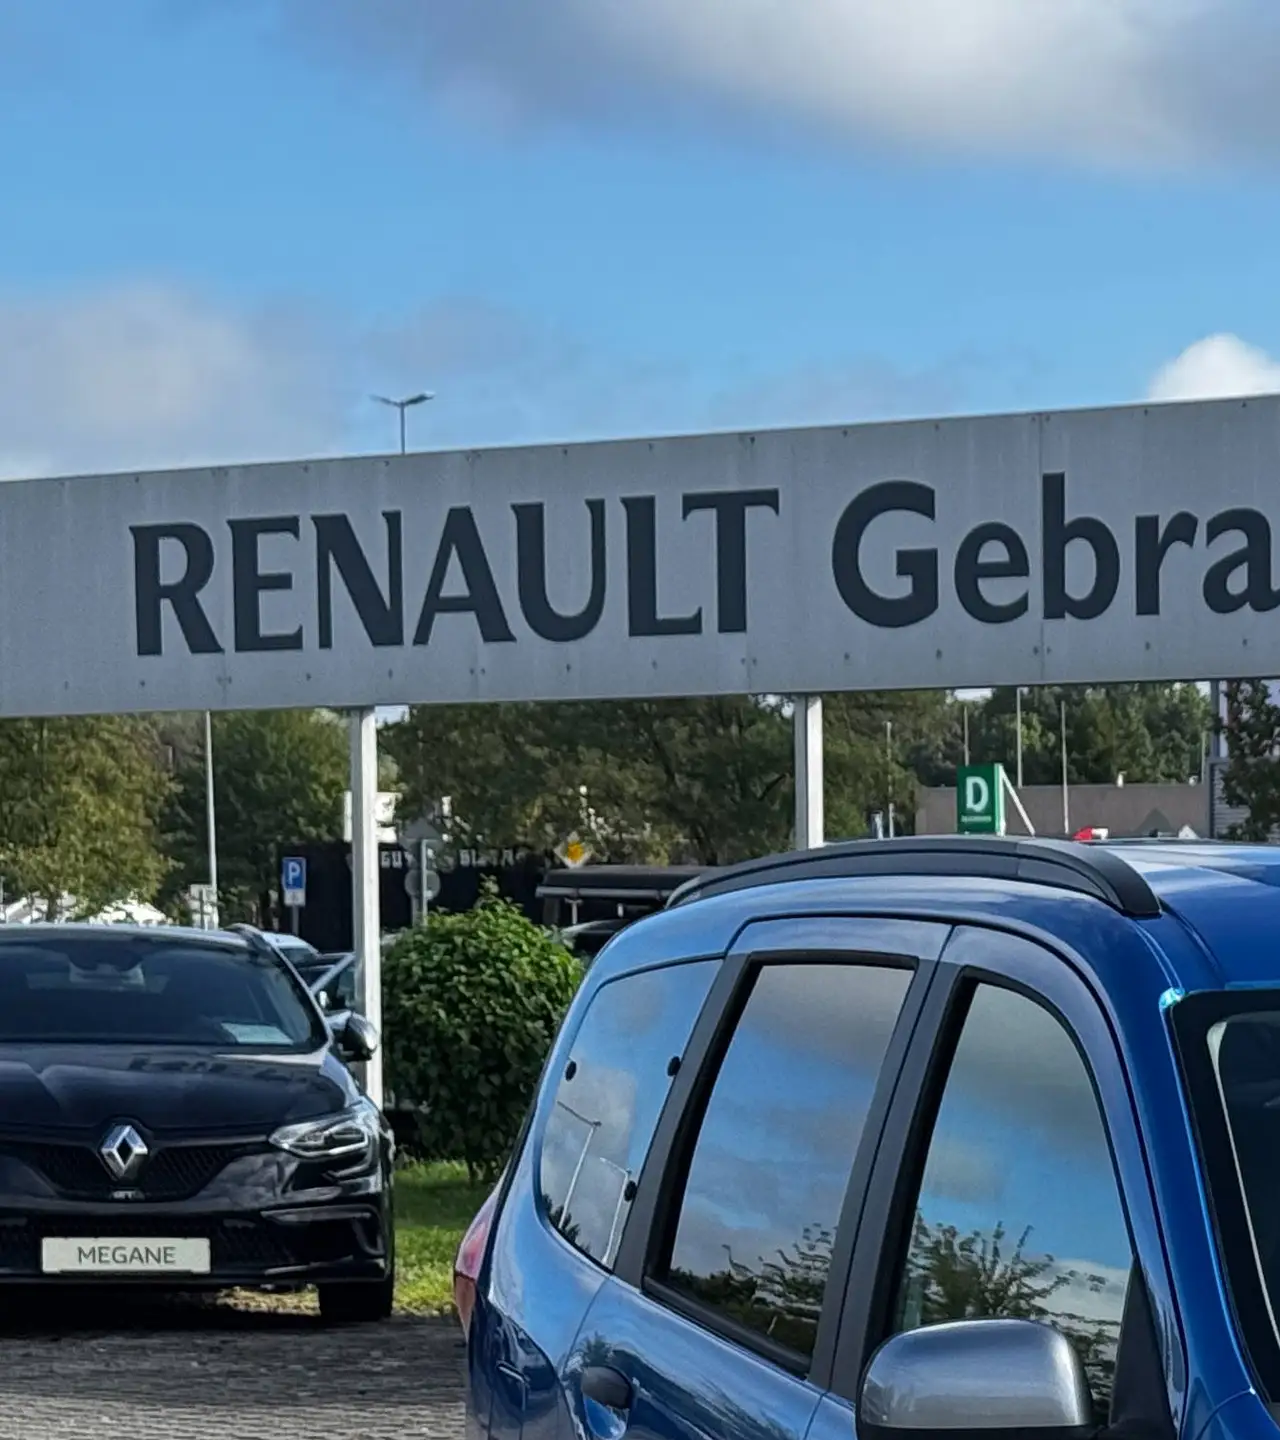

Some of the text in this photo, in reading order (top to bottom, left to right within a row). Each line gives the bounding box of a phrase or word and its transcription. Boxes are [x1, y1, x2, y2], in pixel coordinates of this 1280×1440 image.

[129, 486, 781, 656] RENAULT
[966, 775, 989, 813] D
[287, 861, 301, 886] P
[77, 1246, 176, 1264] MEGANE
